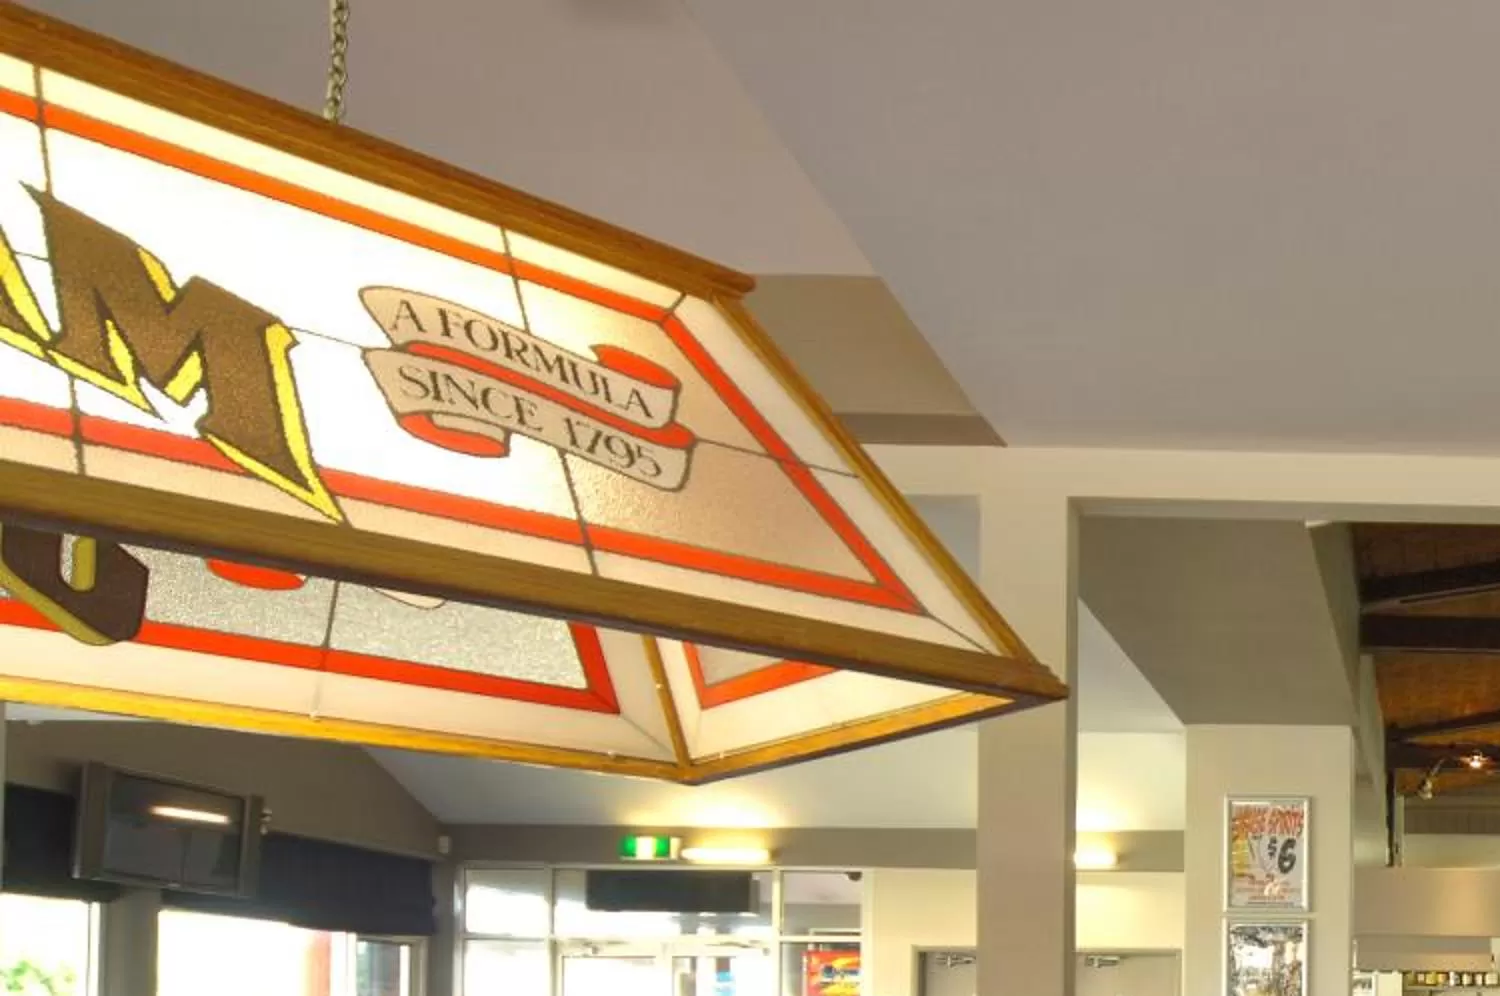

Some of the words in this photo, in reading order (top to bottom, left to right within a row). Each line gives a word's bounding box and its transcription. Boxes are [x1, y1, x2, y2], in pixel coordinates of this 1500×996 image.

[391, 299, 427, 334] A
[435, 307, 654, 419] FORMULA
[398, 364, 543, 432] SINCE
[562, 415, 662, 478] 1795
